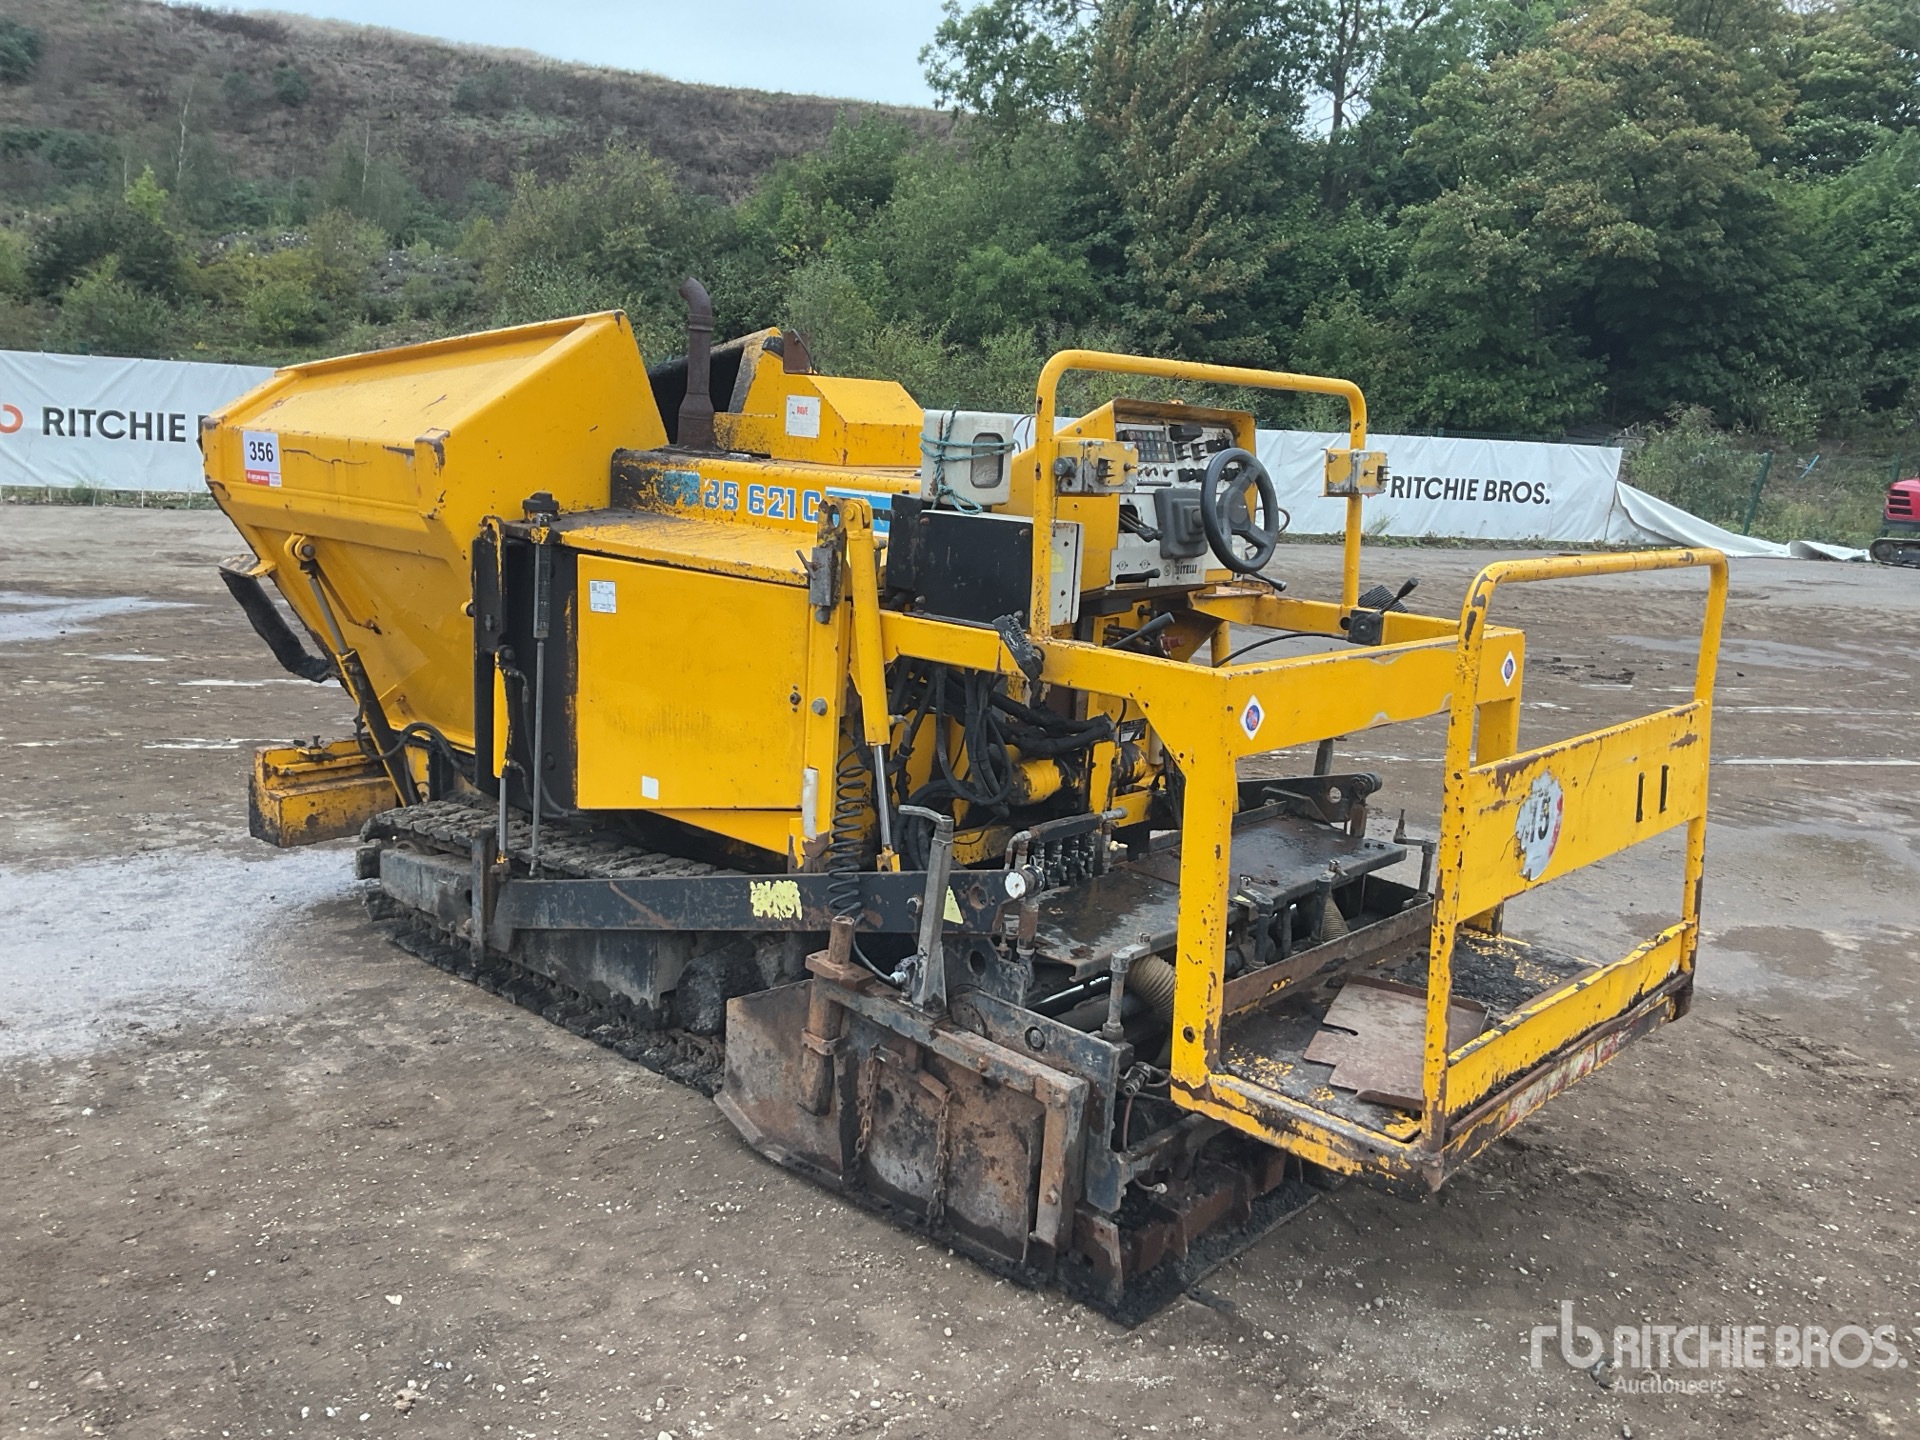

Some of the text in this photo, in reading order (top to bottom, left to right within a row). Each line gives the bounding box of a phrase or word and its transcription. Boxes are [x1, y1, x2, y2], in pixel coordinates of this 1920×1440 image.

[42, 406, 186, 442] RITCHIE
[249, 441, 274, 463] 356
[747, 483, 797, 520] 621
[1390, 475, 1551, 505] RITCHIE BROS.
